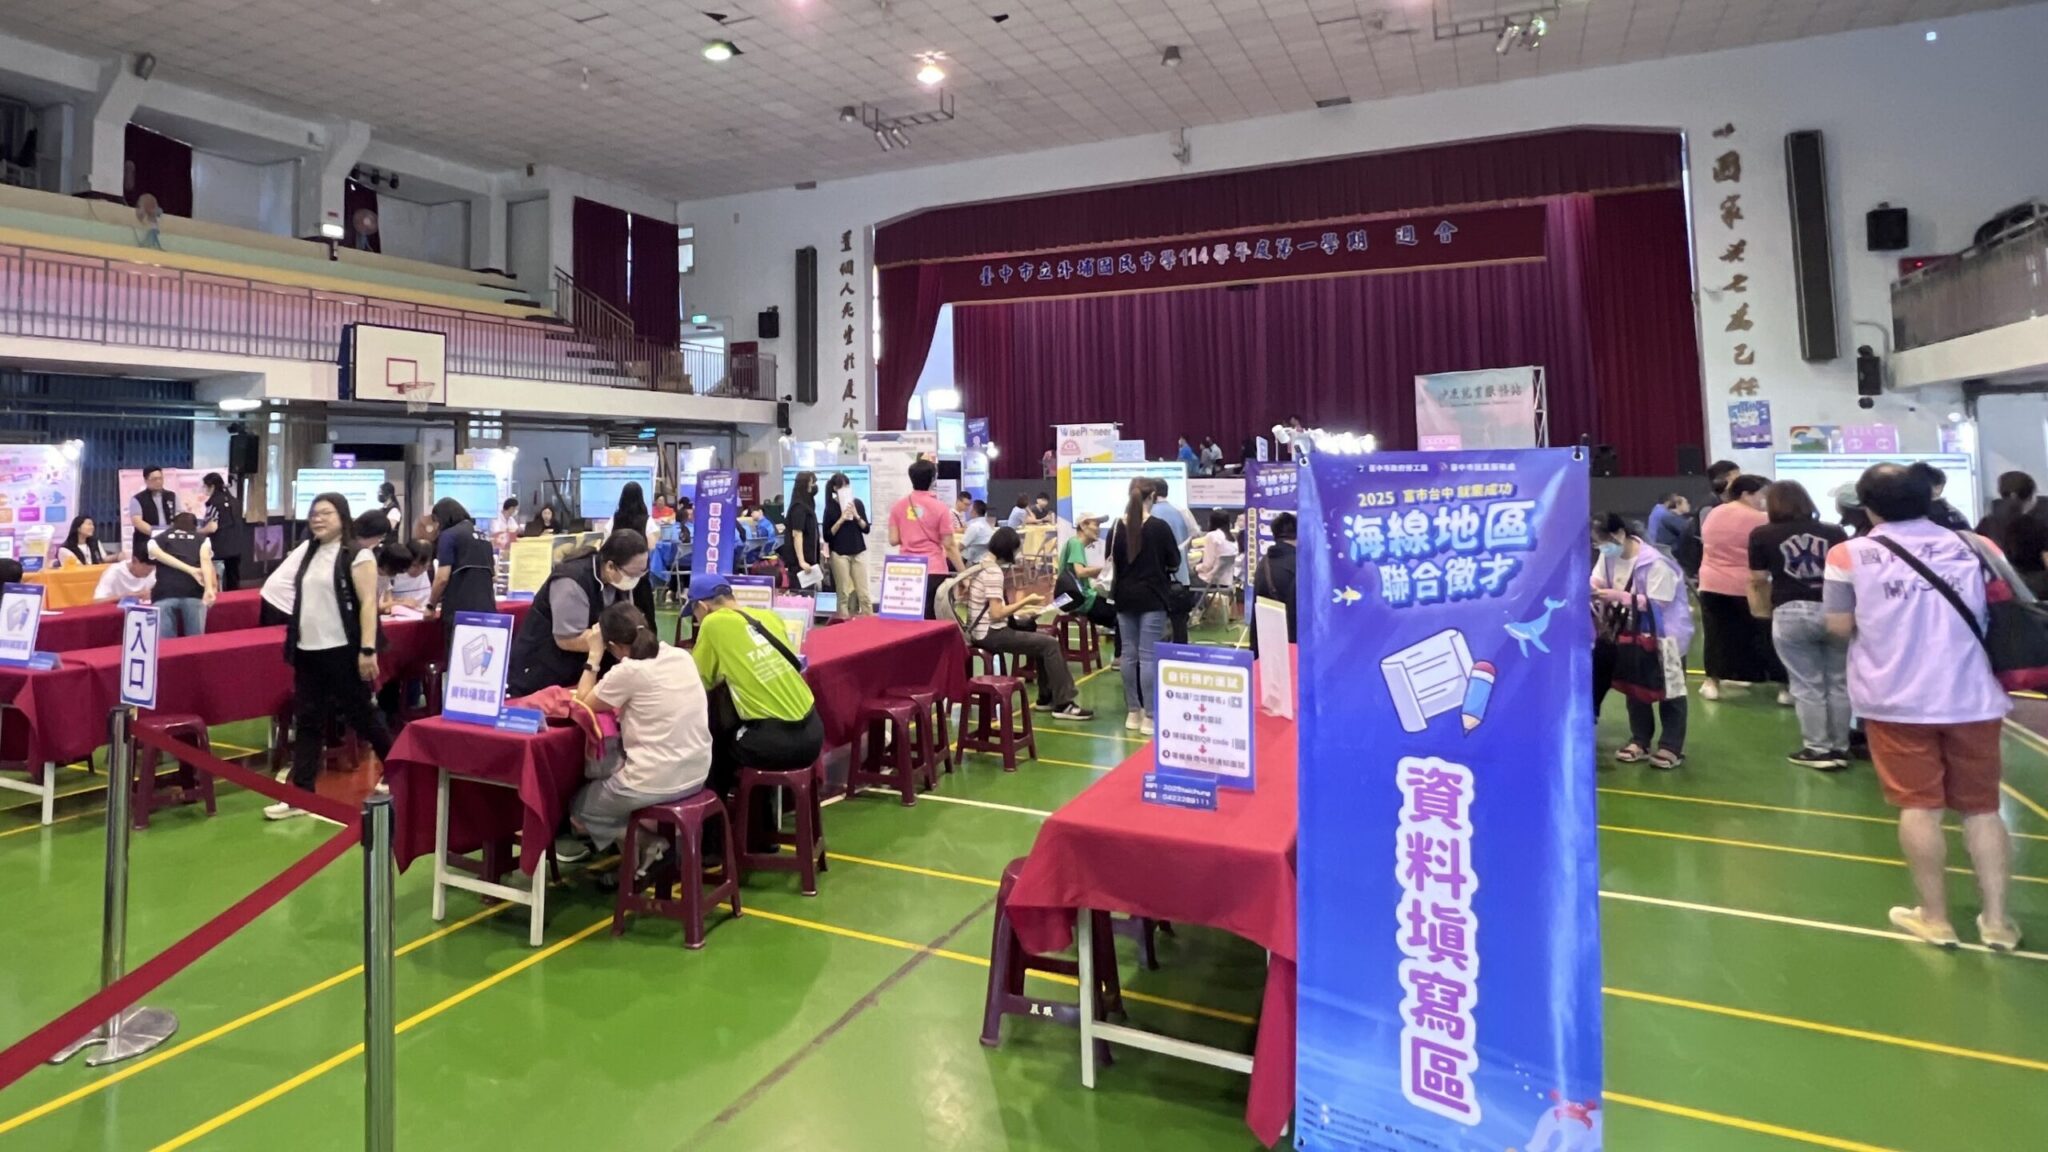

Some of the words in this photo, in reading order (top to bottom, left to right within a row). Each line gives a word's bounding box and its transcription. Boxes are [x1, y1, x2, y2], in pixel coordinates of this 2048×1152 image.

[1357, 491, 1396, 507] 2025
[1343, 500, 1537, 562] 海線地區
[1378, 552, 1516, 603] 聯合徵才
[129, 621, 148, 690] 入口
[1403, 764, 1472, 1115] 資料填寫區
